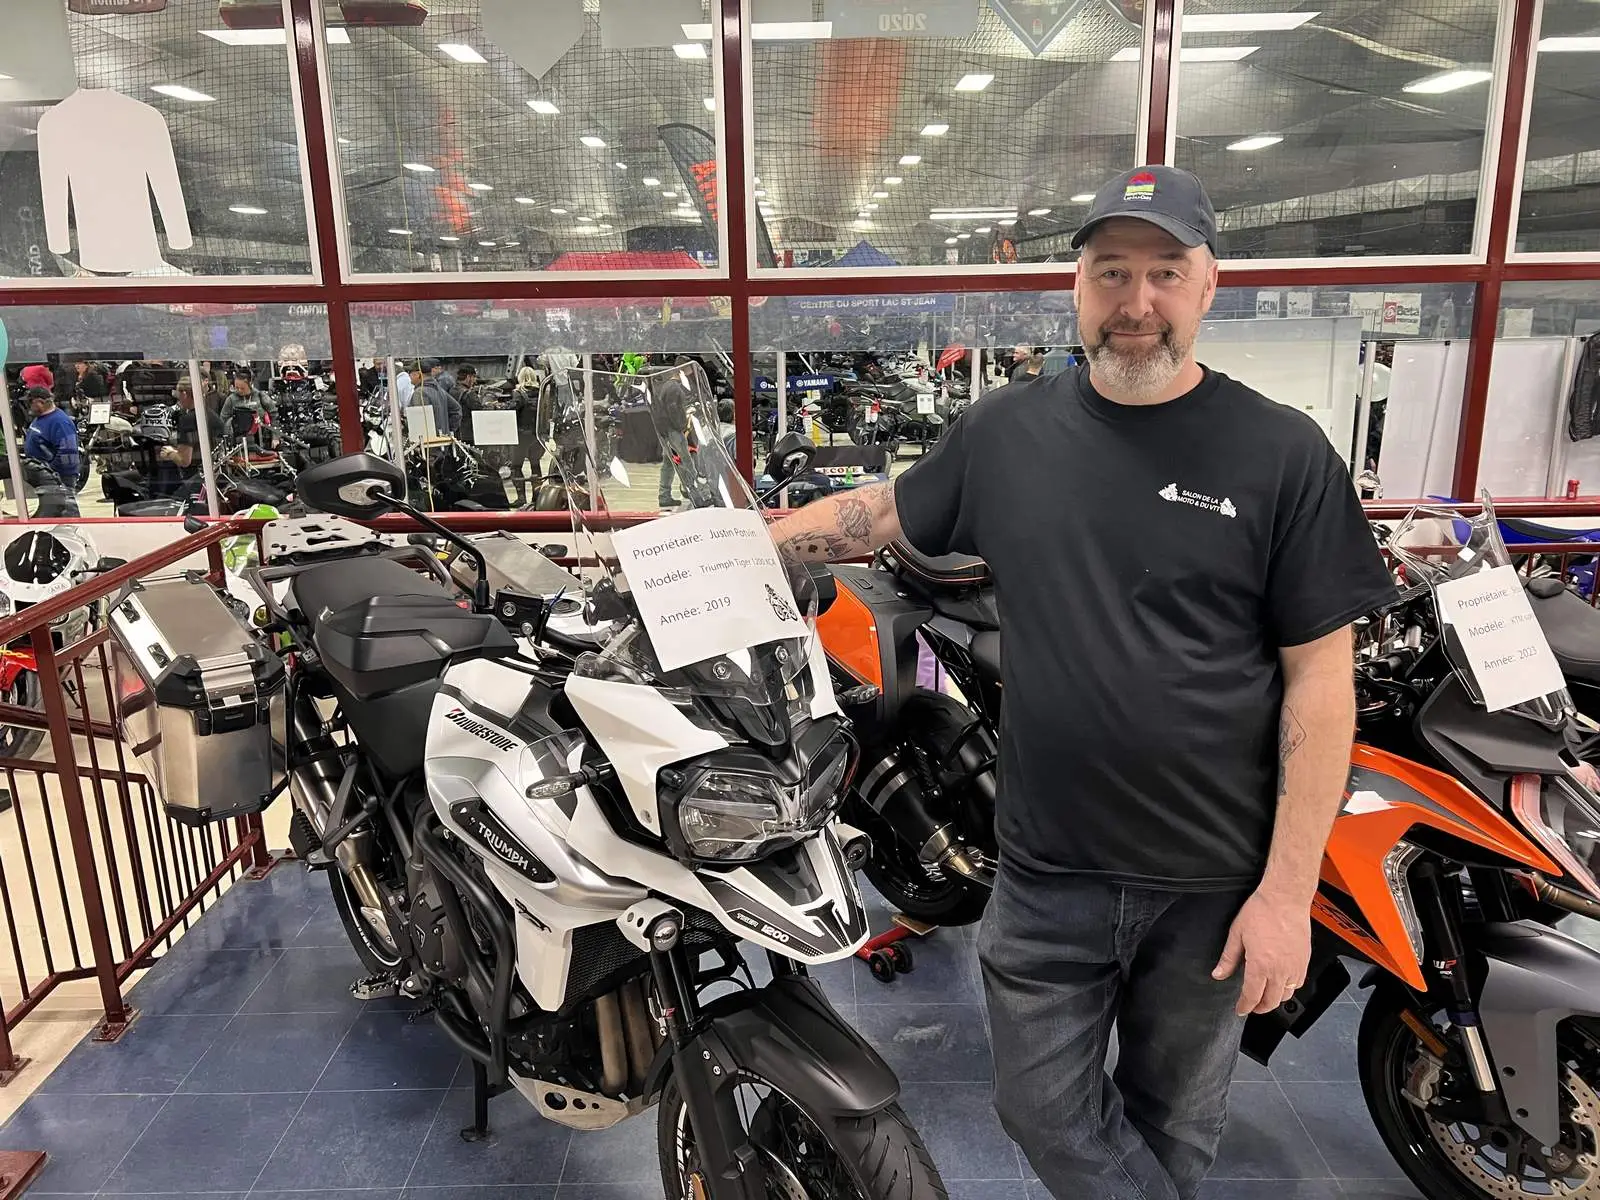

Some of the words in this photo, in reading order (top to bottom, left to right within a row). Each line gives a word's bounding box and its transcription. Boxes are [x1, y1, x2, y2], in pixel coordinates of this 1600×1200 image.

[800, 301, 835, 309] CENTRE
[851, 299, 880, 307] SPORT
[803, 379, 829, 387] YAMAHA
[1178, 496, 1195, 505] MOTO
[1209, 504, 1220, 512] VTT
[1182, 490, 1202, 500] SALON
[1202, 495, 1211, 503] DE
[1210, 497, 1219, 505] LA
[632, 532, 704, 560] Propriétaire:
[709, 527, 735, 540] Justin
[643, 569, 692, 590] Modèle:
[699, 559, 735, 574] Triumph
[659, 606, 701, 626] Année:
[704, 596, 732, 612] 2019
[1518, 646, 1538, 660] 2023
[445, 708, 519, 752] BRIDGESTONE
[478, 821, 529, 871] TRIUMPH
[761, 924, 790, 943] 1200
